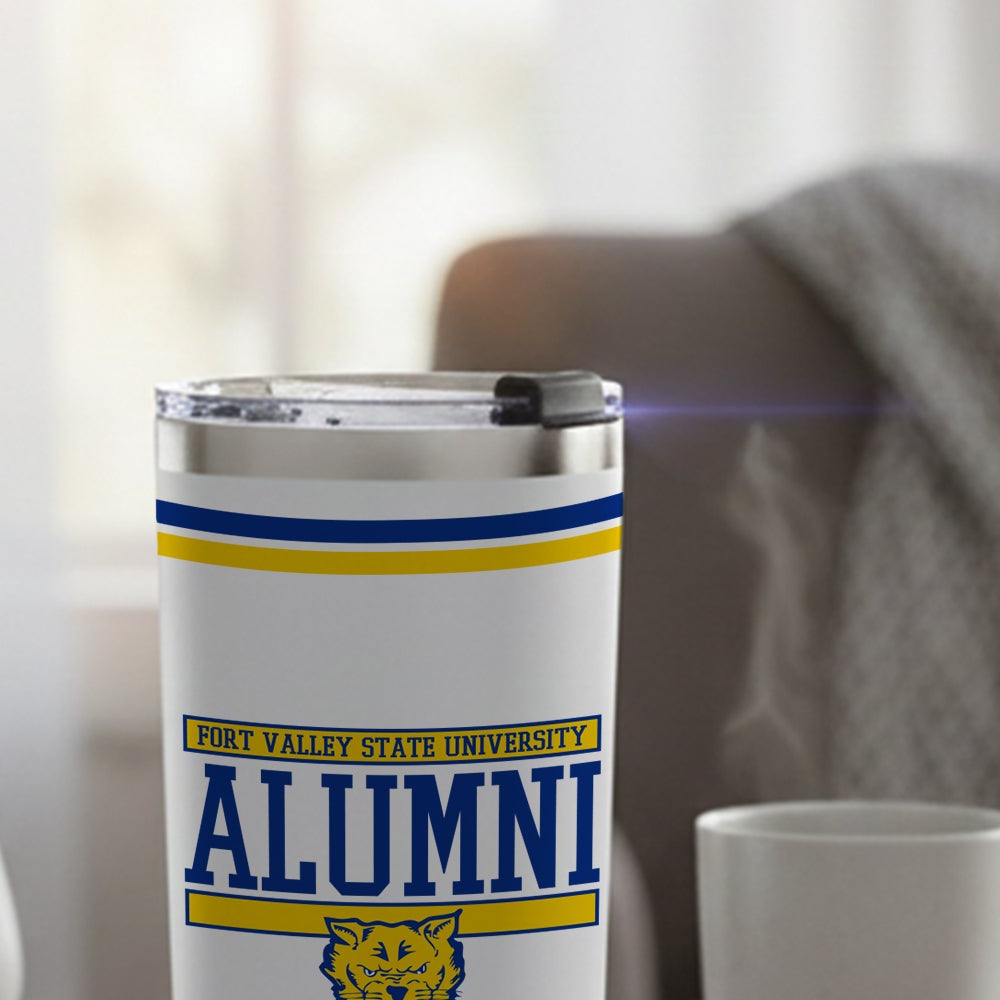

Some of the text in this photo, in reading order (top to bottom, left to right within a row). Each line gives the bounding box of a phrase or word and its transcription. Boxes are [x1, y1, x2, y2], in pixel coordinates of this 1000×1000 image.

[197, 725, 587, 758] FORT VALLEY STATE UNIVERSITY
[185, 760, 602, 897] ALUMNI
